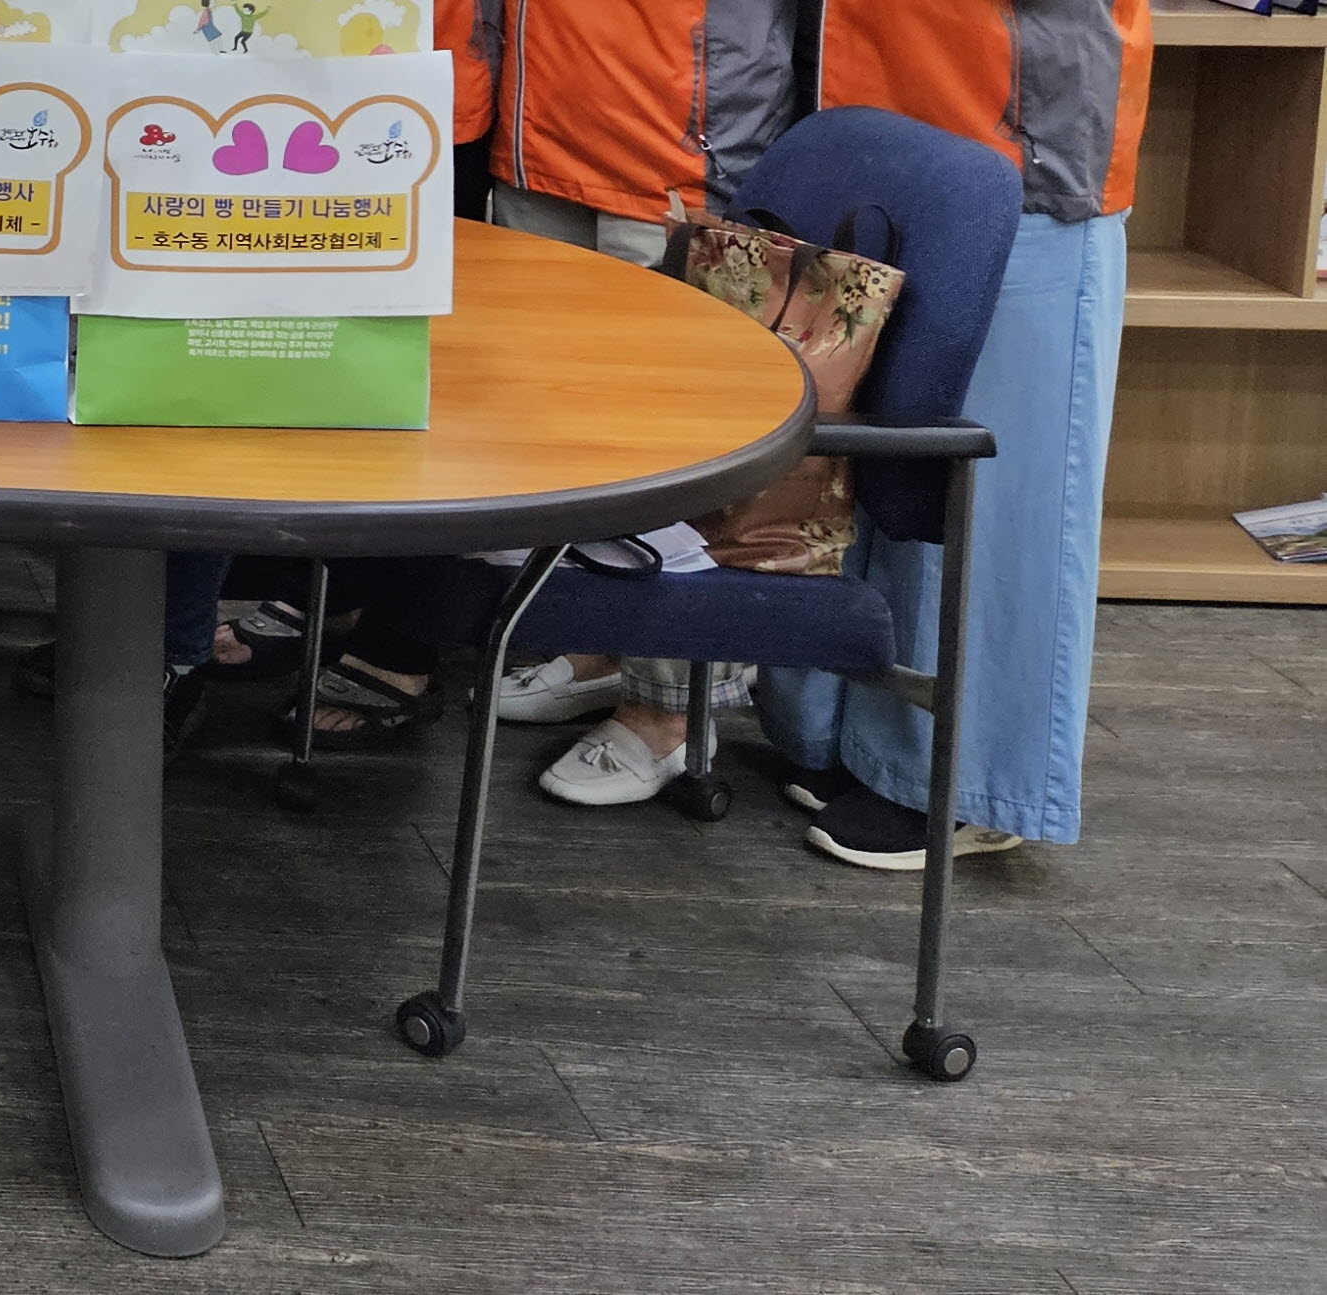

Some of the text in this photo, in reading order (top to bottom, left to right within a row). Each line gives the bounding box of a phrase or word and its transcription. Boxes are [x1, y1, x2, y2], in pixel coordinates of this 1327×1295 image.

[144, 196, 391, 218] 사랑의 빵 만들기 나눔행사
[152, 231, 381, 250] 호수동 지역사회보장협의체
